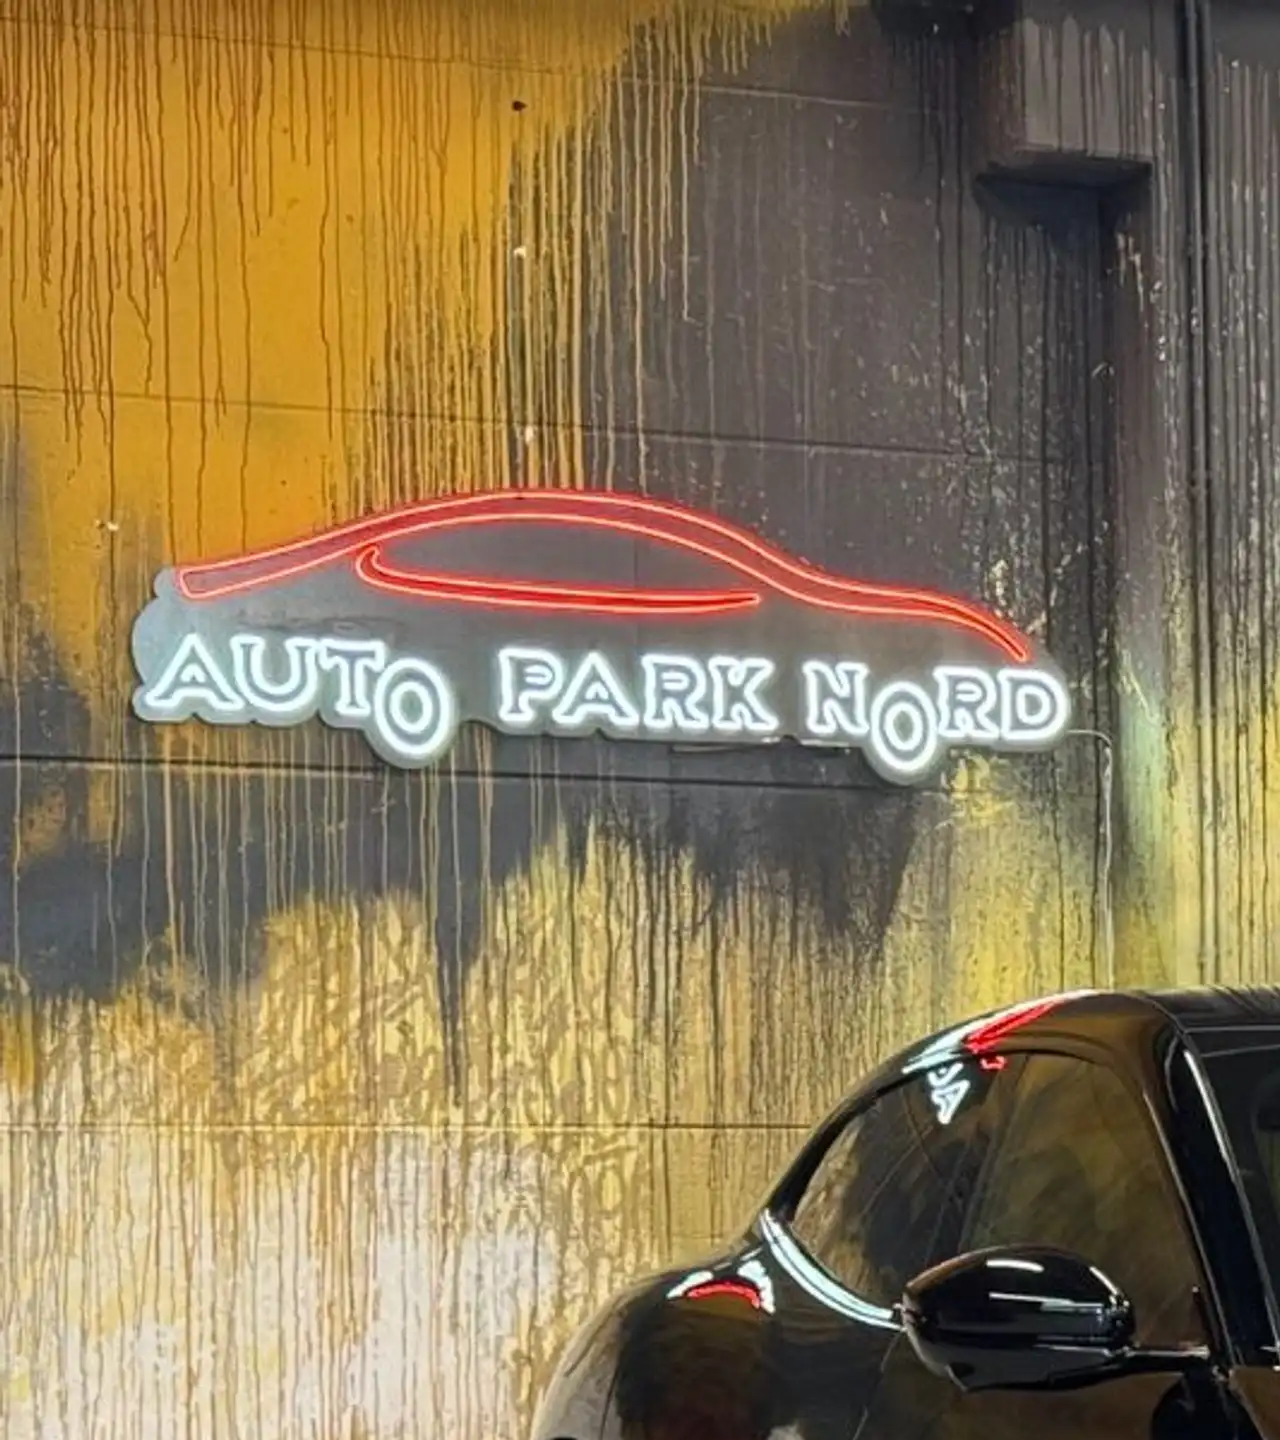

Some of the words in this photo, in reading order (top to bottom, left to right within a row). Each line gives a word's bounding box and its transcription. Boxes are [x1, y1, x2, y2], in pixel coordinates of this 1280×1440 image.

[144, 633, 455, 757] AUTO
[498, 649, 780, 732] PARK
[802, 660, 1072, 772] NORD
